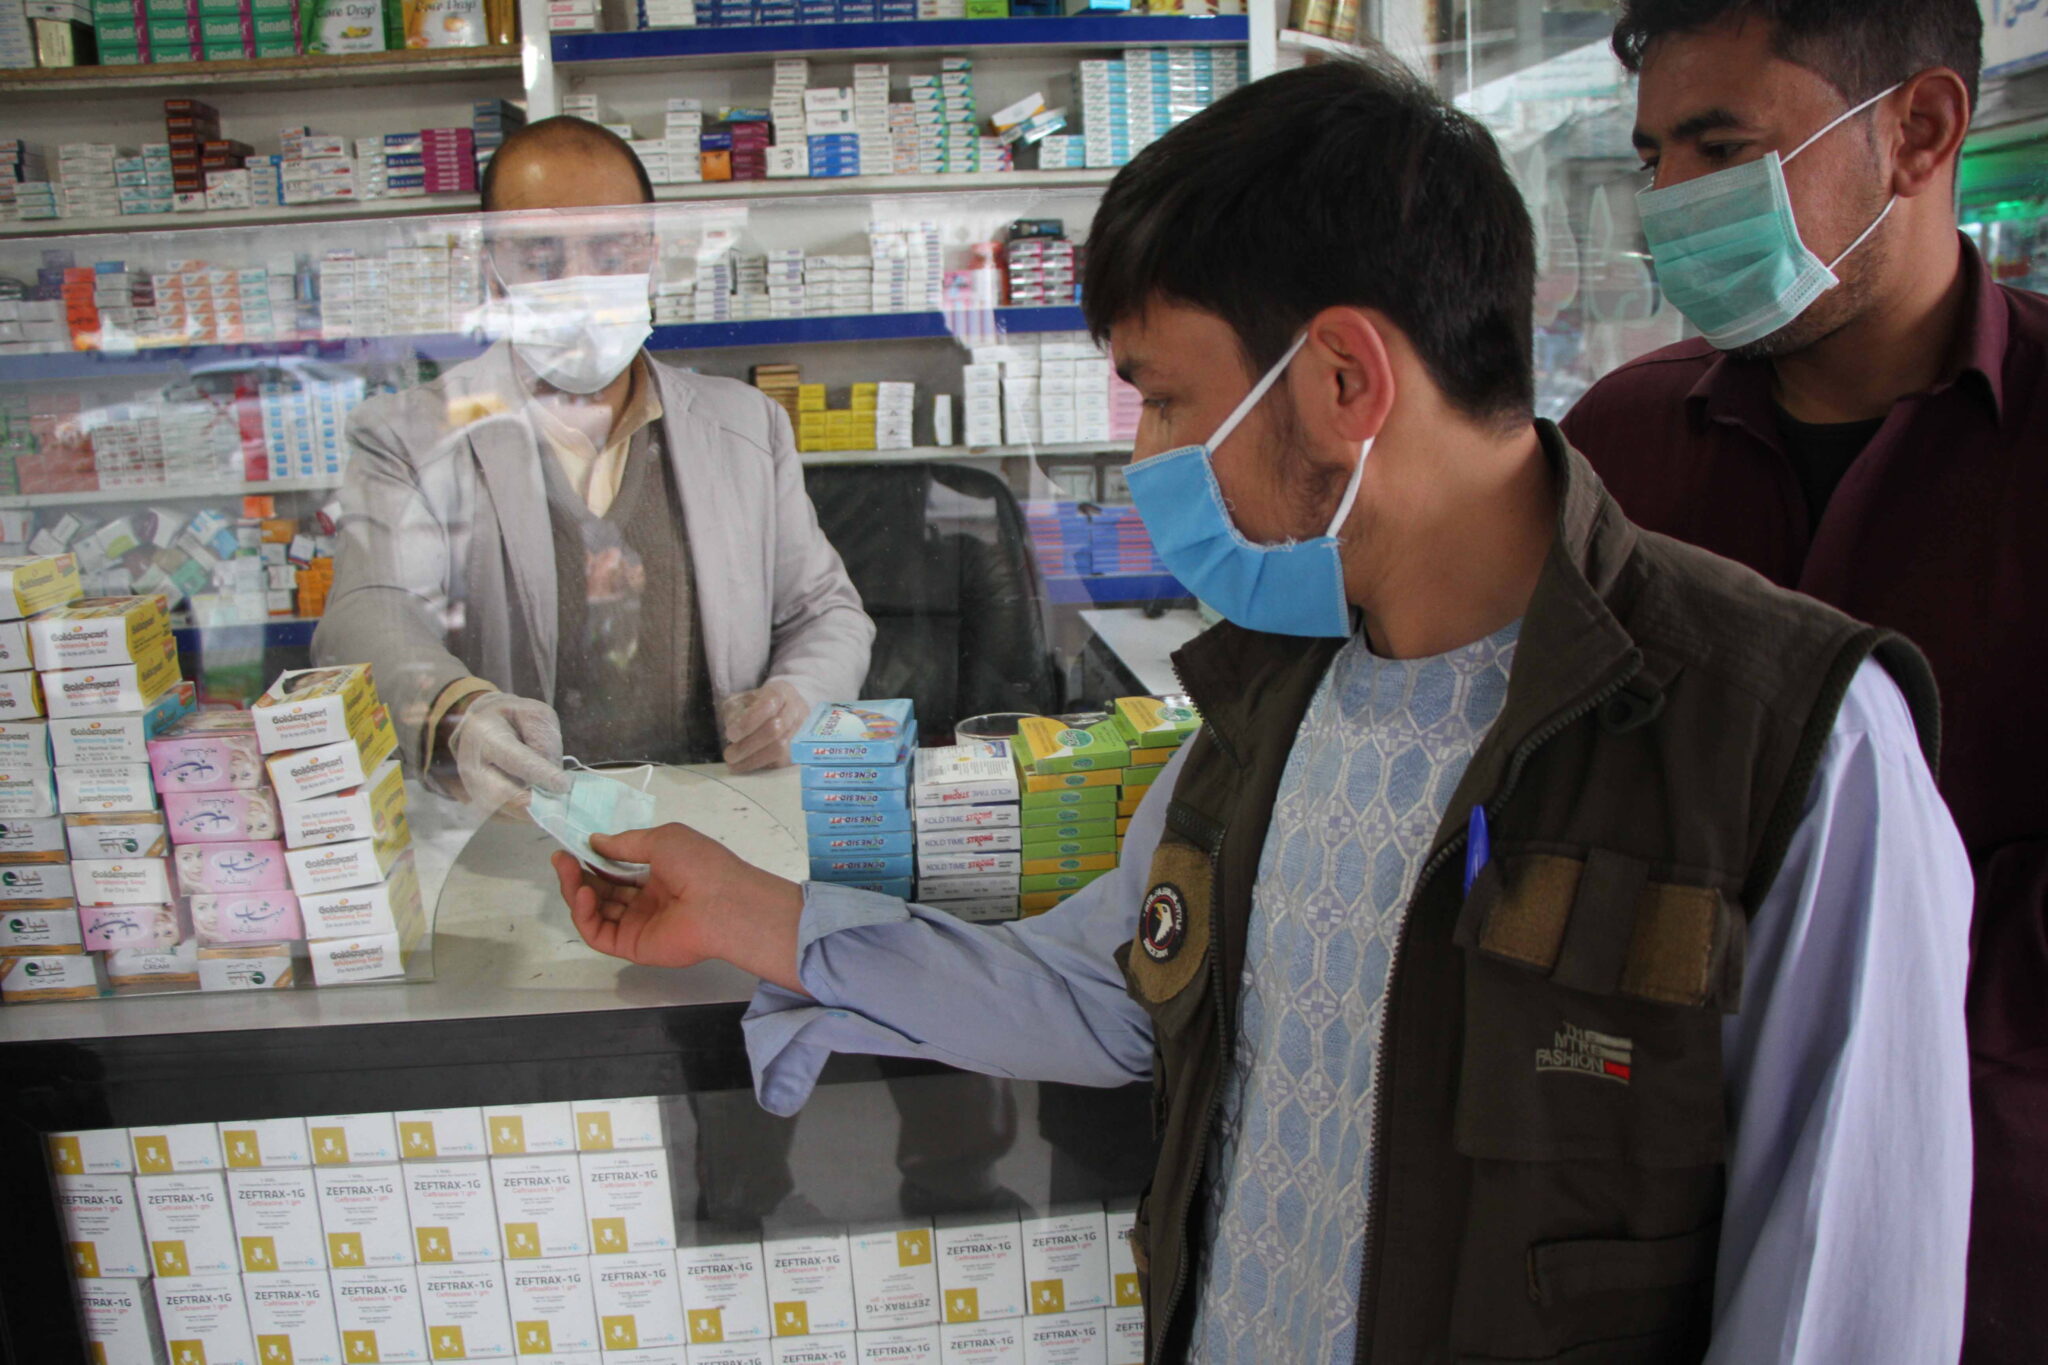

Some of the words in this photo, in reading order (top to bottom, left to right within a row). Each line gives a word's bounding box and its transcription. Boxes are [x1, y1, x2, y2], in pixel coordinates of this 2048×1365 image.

[1536, 1048, 1605, 1073] FASHION
[503, 1175, 570, 1187] ZEFTRAX-1G
[591, 1170, 658, 1182] ZEFTRAX-1G
[326, 1185, 393, 1196] ZEFTRAX-1G
[414, 1179, 481, 1191] ZEFTRAX-1G
[148, 1193, 214, 1205] ZEFTRAX-1G
[238, 1189, 306, 1200] ZEFTRAX-1G
[1032, 1232, 1097, 1247] ZEFTRAX-1G
[946, 1242, 1012, 1256] ZEFTRAX-1G
[775, 1255, 840, 1268] ZEFTRAX-1G
[601, 1269, 666, 1282] ZEFTRAX-1G
[688, 1262, 753, 1276] ZEFTRAX-1G
[428, 1279, 493, 1292] ZEFTRAX-1G
[515, 1274, 581, 1286] ZEFTRAX-1G
[255, 1290, 320, 1301] ZEFTRAX-1G
[341, 1284, 407, 1296] ZEFTRAX-1G
[166, 1293, 232, 1306] ZEFTRAX-1G
[1033, 1327, 1096, 1342] ZEFTRAX-1G
[950, 1336, 1014, 1350] ZEFTRAX-1G
[866, 1344, 930, 1357] ZEFTRAX-1G
[782, 1351, 847, 1364] ZEFTRAX-1G
